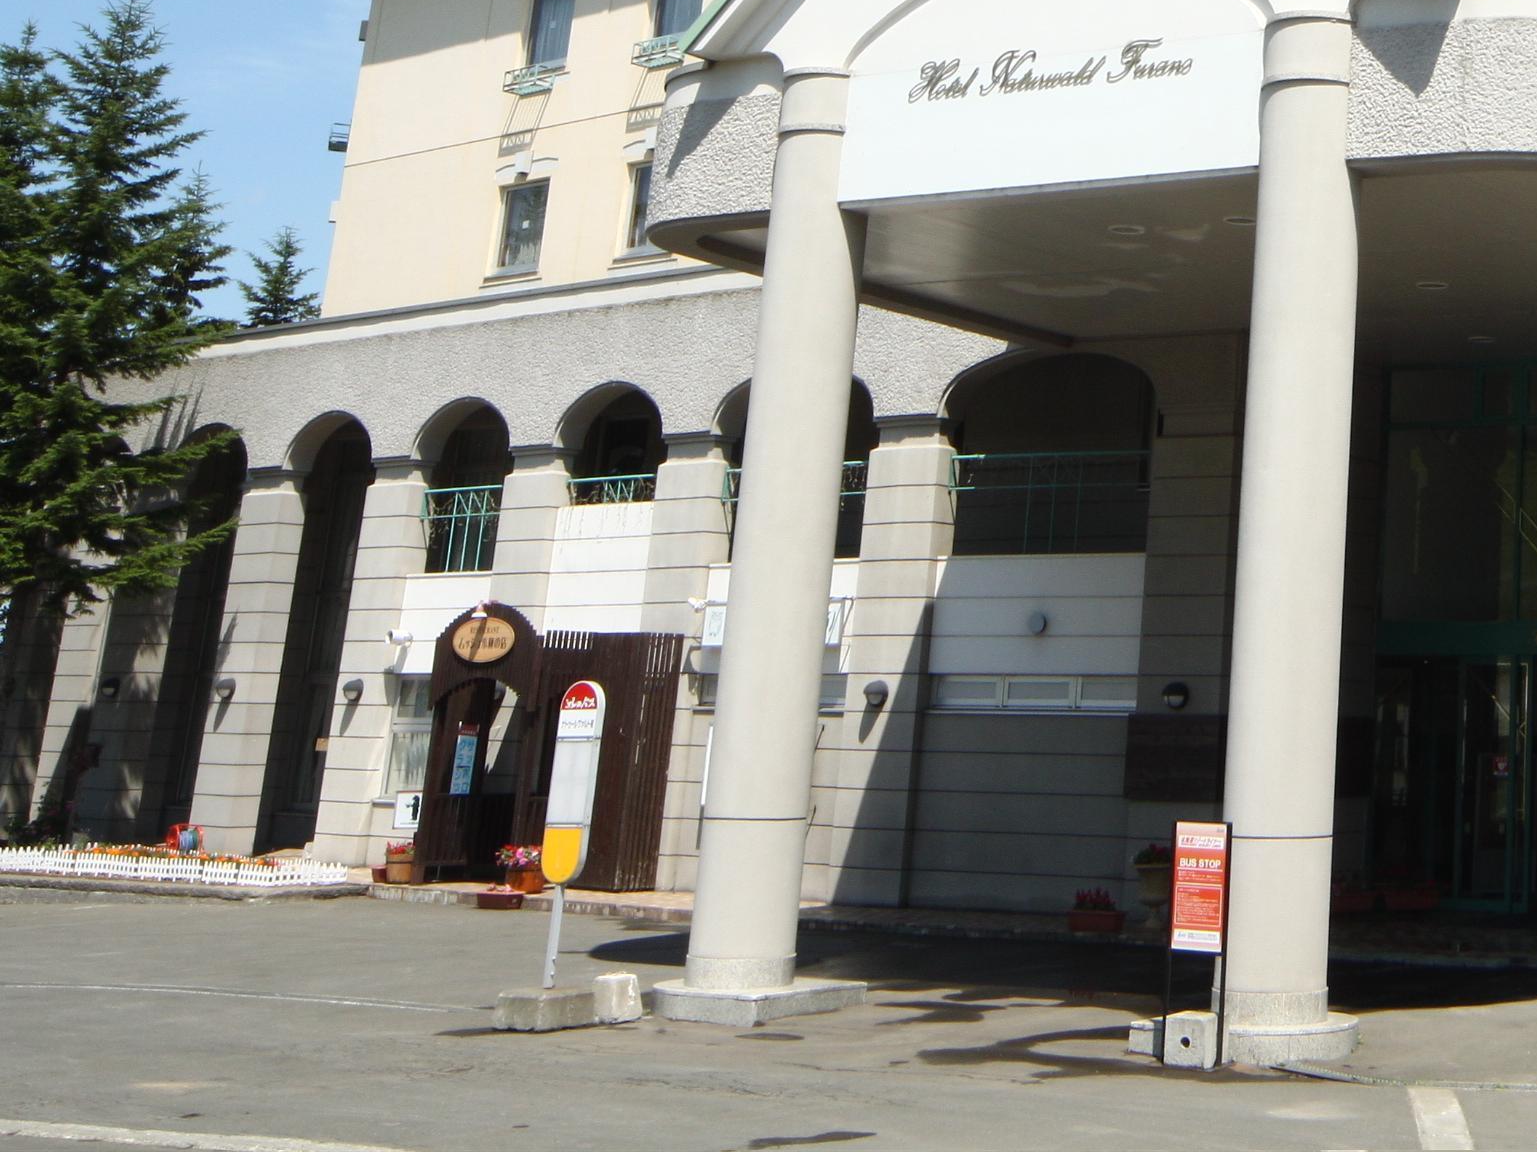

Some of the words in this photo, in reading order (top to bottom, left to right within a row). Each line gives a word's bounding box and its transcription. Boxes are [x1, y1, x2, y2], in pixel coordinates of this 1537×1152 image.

[908, 58, 980, 104] Hotel
[980, 49, 1106, 97] Naturwald
[1106, 37, 1194, 84] Furano
[470, 626, 500, 634] RERANT
[1180, 857, 1197, 868] BUS
[1198, 859, 1222, 869] STOP
